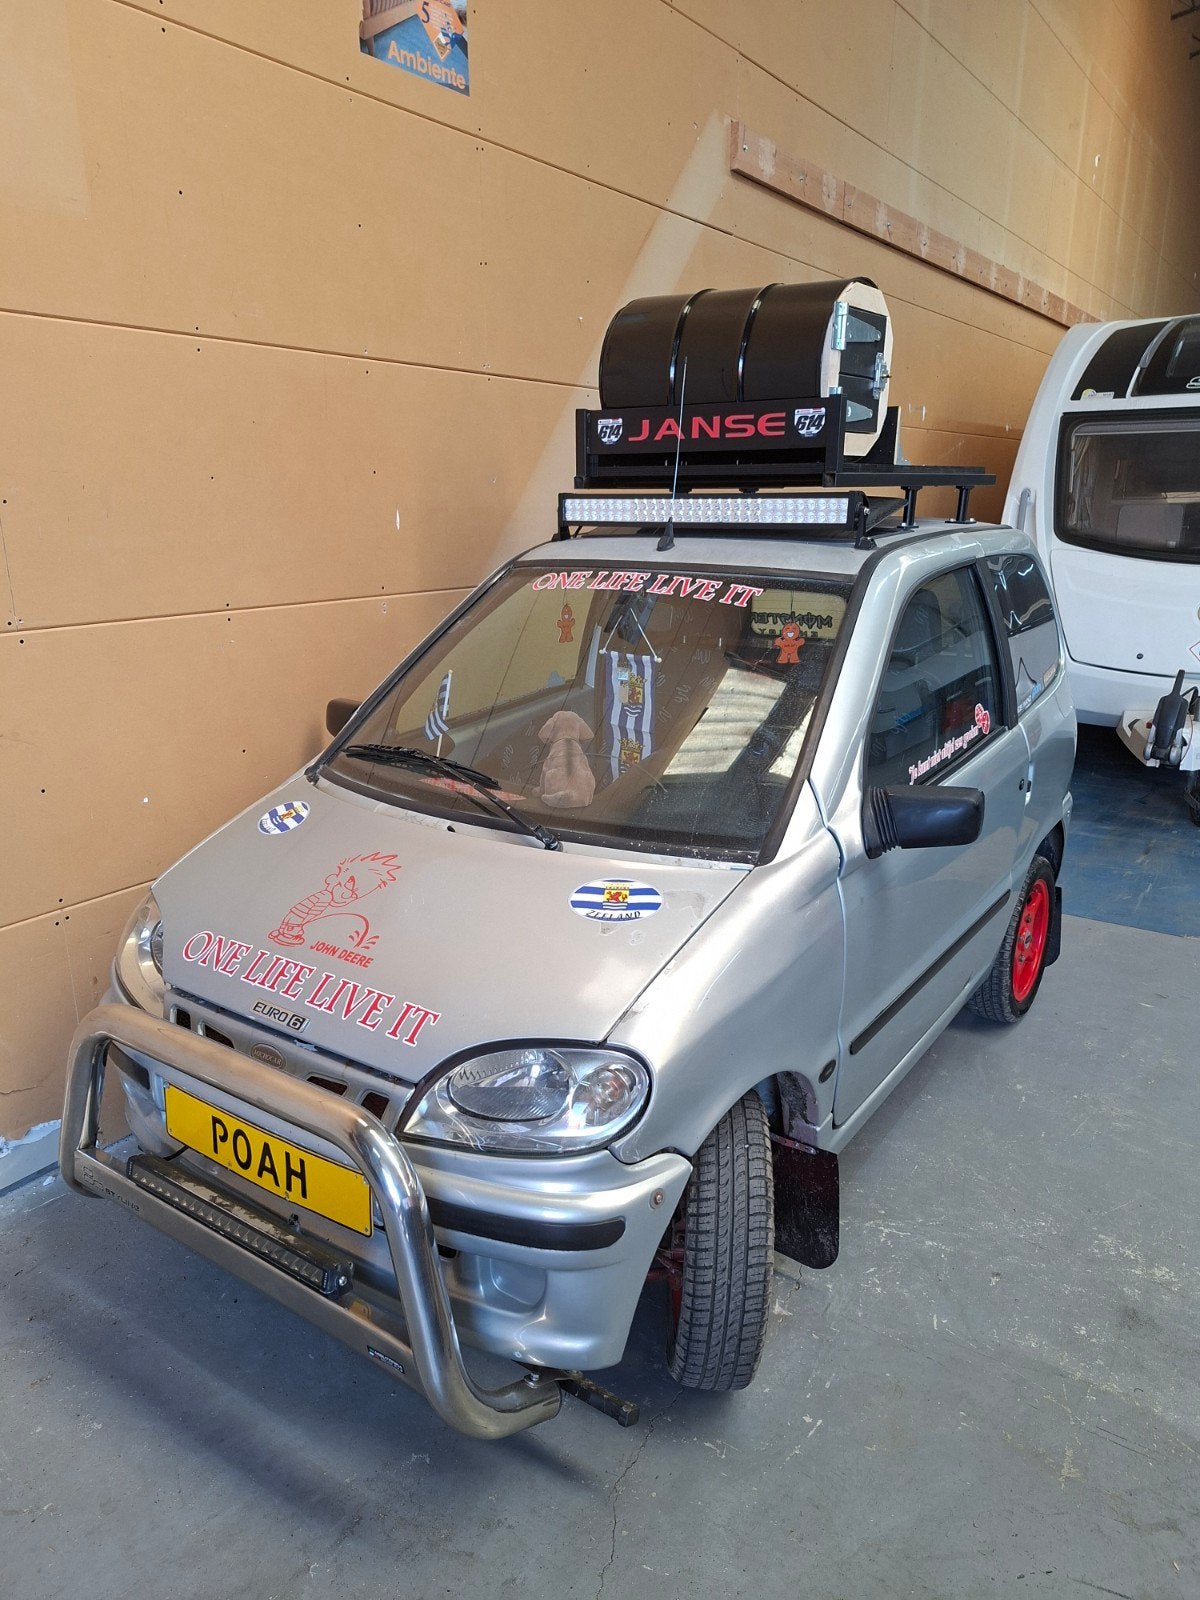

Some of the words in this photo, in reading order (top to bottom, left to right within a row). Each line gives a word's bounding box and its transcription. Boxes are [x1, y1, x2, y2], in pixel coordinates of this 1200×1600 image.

[388, 40, 466, 90] Ambiente
[600, 424, 622, 439] 614
[628, 412, 786, 441] JANSE
[796, 415, 825, 430] 614
[532, 571, 592, 591] ONE
[586, 570, 651, 592] LIFE
[646, 572, 726, 603] LIVE
[719, 584, 764, 608] IT
[310, 940, 337, 957] JOHN
[337, 949, 374, 969] DEERE
[183, 930, 253, 977] ONE
[241, 948, 314, 1000] LIFE
[305, 970, 395, 1030] LIVE
[386, 1001, 442, 1048] IT
[253, 1002, 289, 1022] EURO
[211, 1115, 308, 1199] POAH
